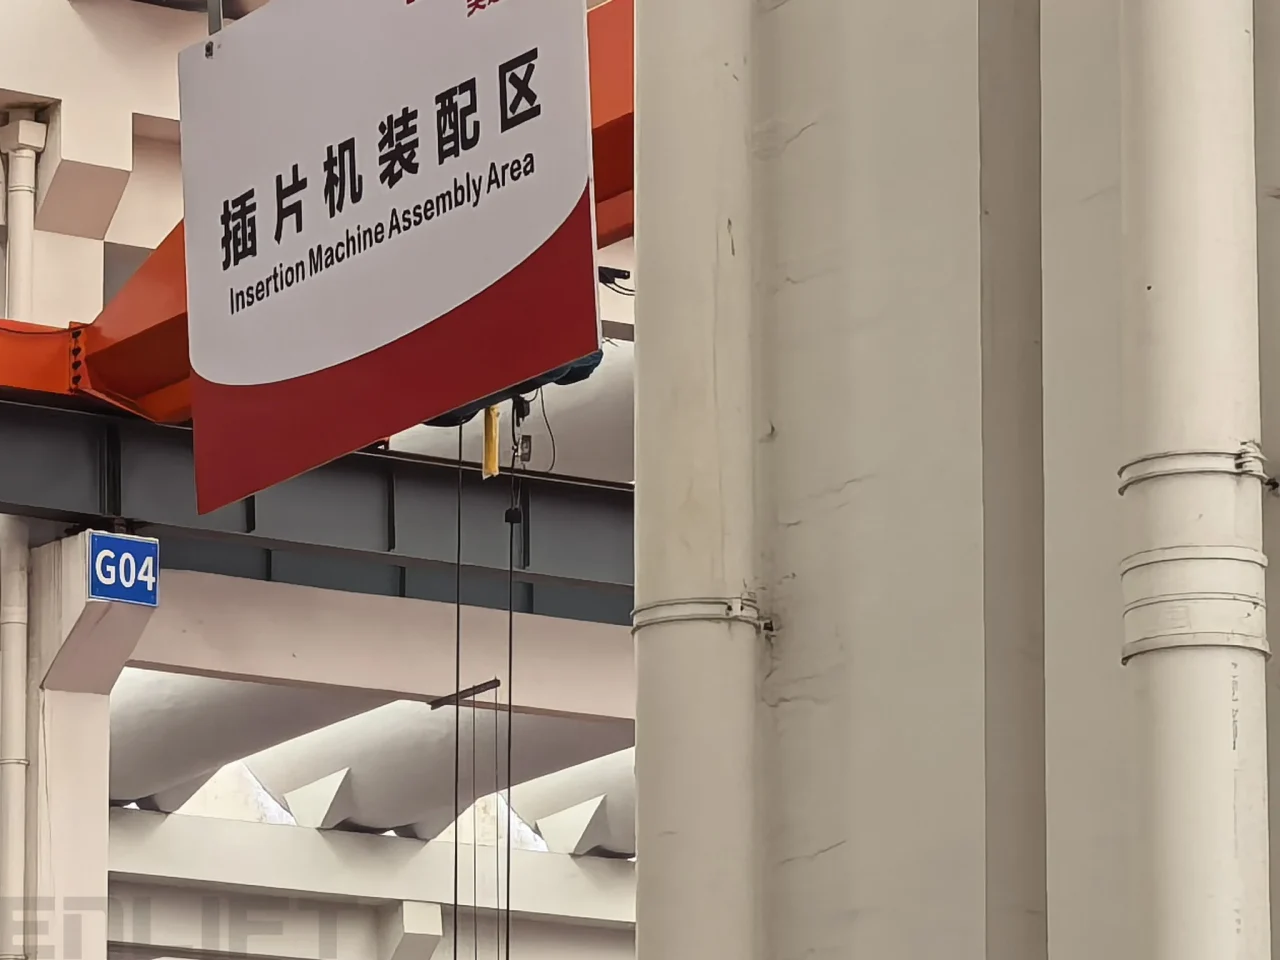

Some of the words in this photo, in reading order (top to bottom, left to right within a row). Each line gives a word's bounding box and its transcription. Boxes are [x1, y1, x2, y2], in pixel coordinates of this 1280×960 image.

[221, 47, 541, 270] 插片机装配区
[230, 260, 306, 315] Insertion
[309, 222, 386, 276] Machine
[388, 172, 484, 240] Assembly
[486, 149, 536, 194] Area
[95, 549, 156, 591] G04
